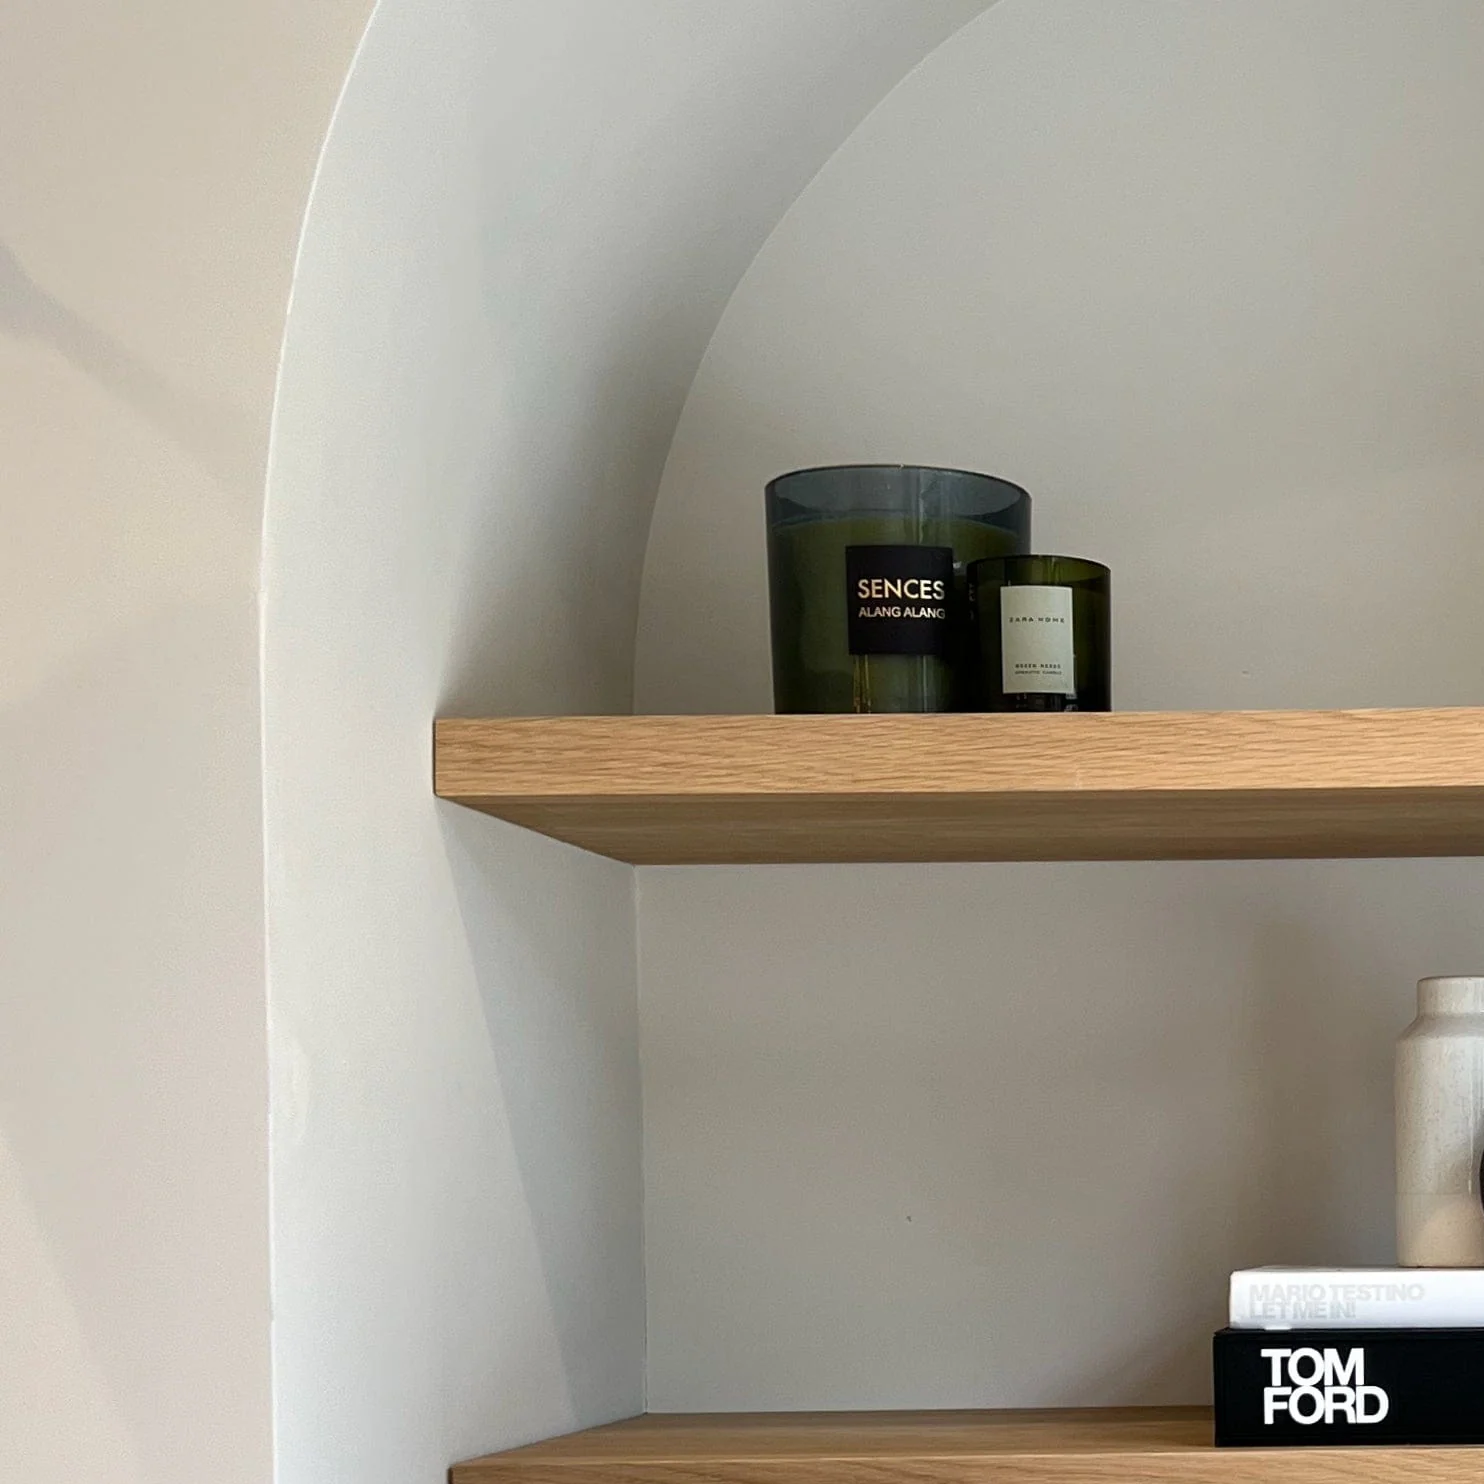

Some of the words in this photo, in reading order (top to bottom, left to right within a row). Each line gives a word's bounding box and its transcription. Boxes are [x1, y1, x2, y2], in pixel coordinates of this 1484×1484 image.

[857, 578, 945, 600] SENCES
[858, 606, 901, 618] ALANG
[903, 606, 945, 619] ALANG
[1250, 1283, 1326, 1302] MARIO
[1329, 1283, 1426, 1302] TESTINO
[1250, 1301, 1289, 1319] LET
[1292, 1301, 1327, 1319] ME
[1329, 1301, 1356, 1319] IN!
[1261, 1347, 1364, 1387] TOM
[1263, 1385, 1389, 1425] FORD
